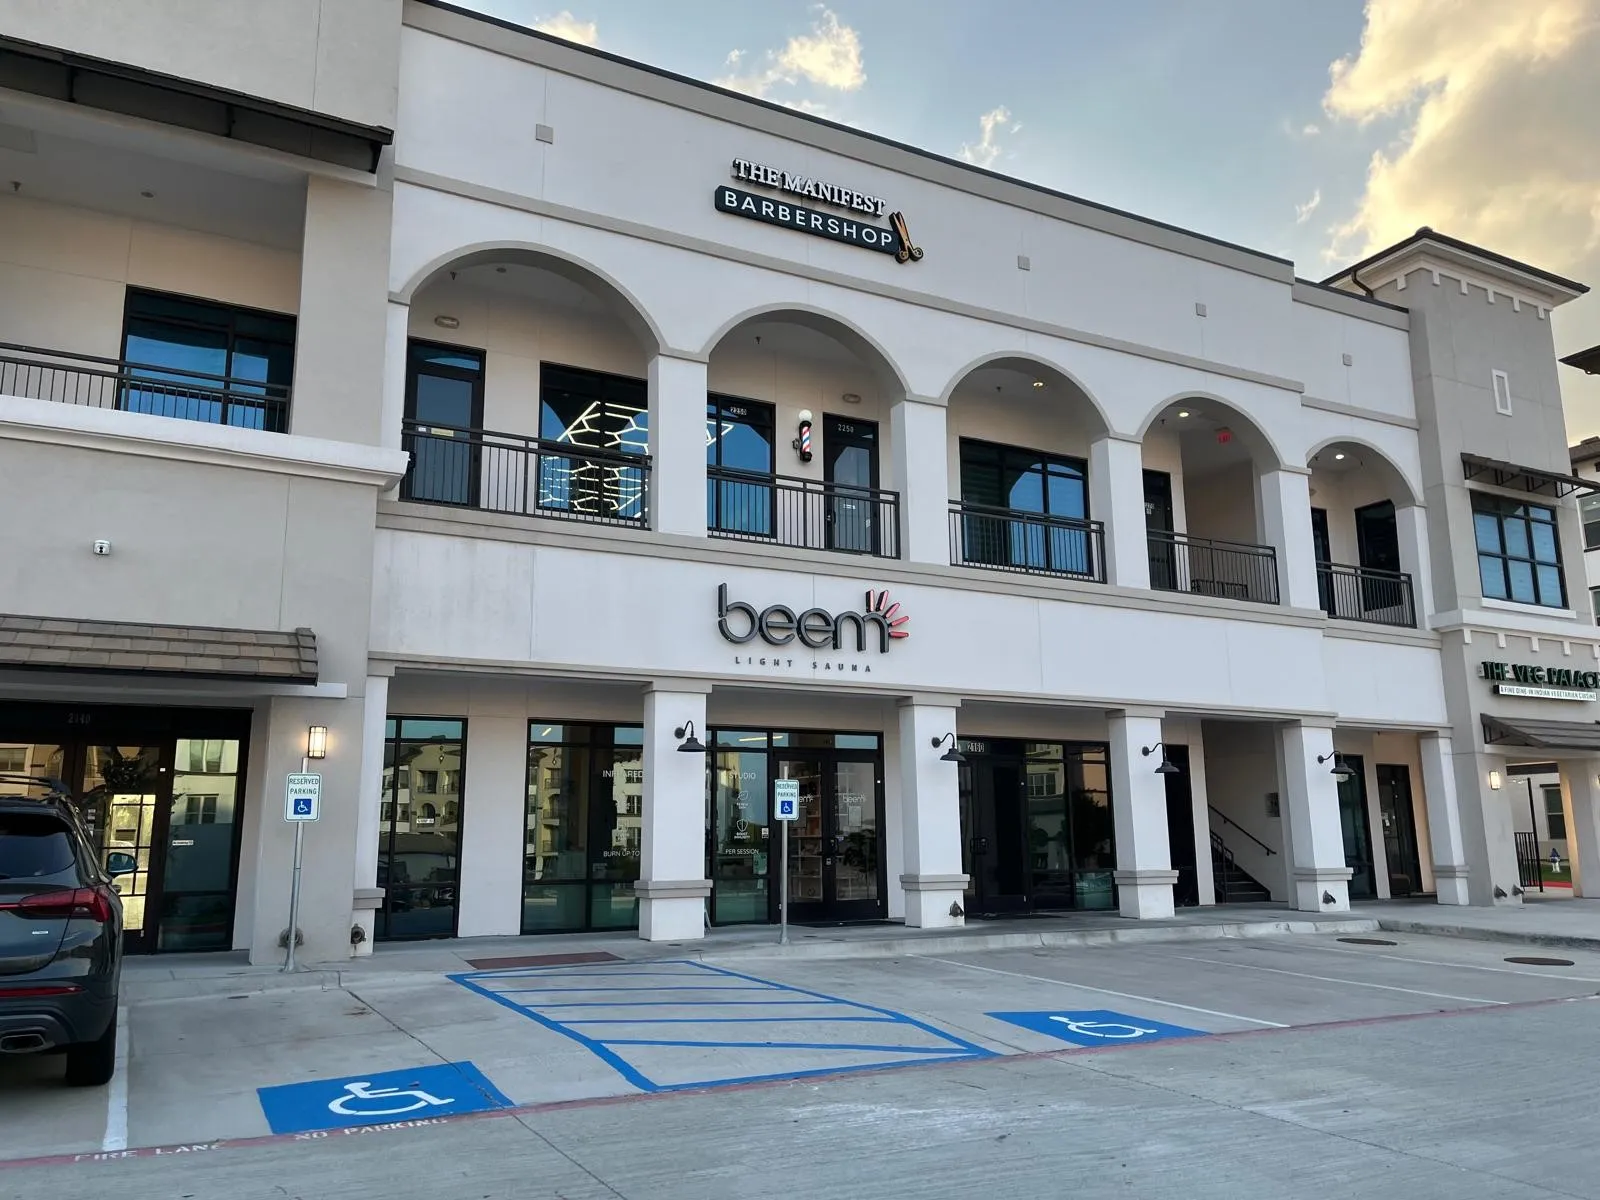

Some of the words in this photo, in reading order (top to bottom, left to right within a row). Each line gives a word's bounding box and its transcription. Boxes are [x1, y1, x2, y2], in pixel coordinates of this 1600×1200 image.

[734, 158, 779, 187] THE
[782, 171, 886, 216] MANIFEST
[724, 190, 893, 247] BARBERSHOP
[717, 582, 893, 654] beem
[735, 656, 793, 668] LIGHT
[812, 661, 871, 673] SAUNA
[1481, 661, 1509, 681] THE
[1511, 663, 1546, 684] VEG
[729, 772, 757, 780] STUDIO
[294, 1131, 328, 1141] NO
[343, 1118, 449, 1135] PARKING
[75, 1149, 138, 1162] FIRE
